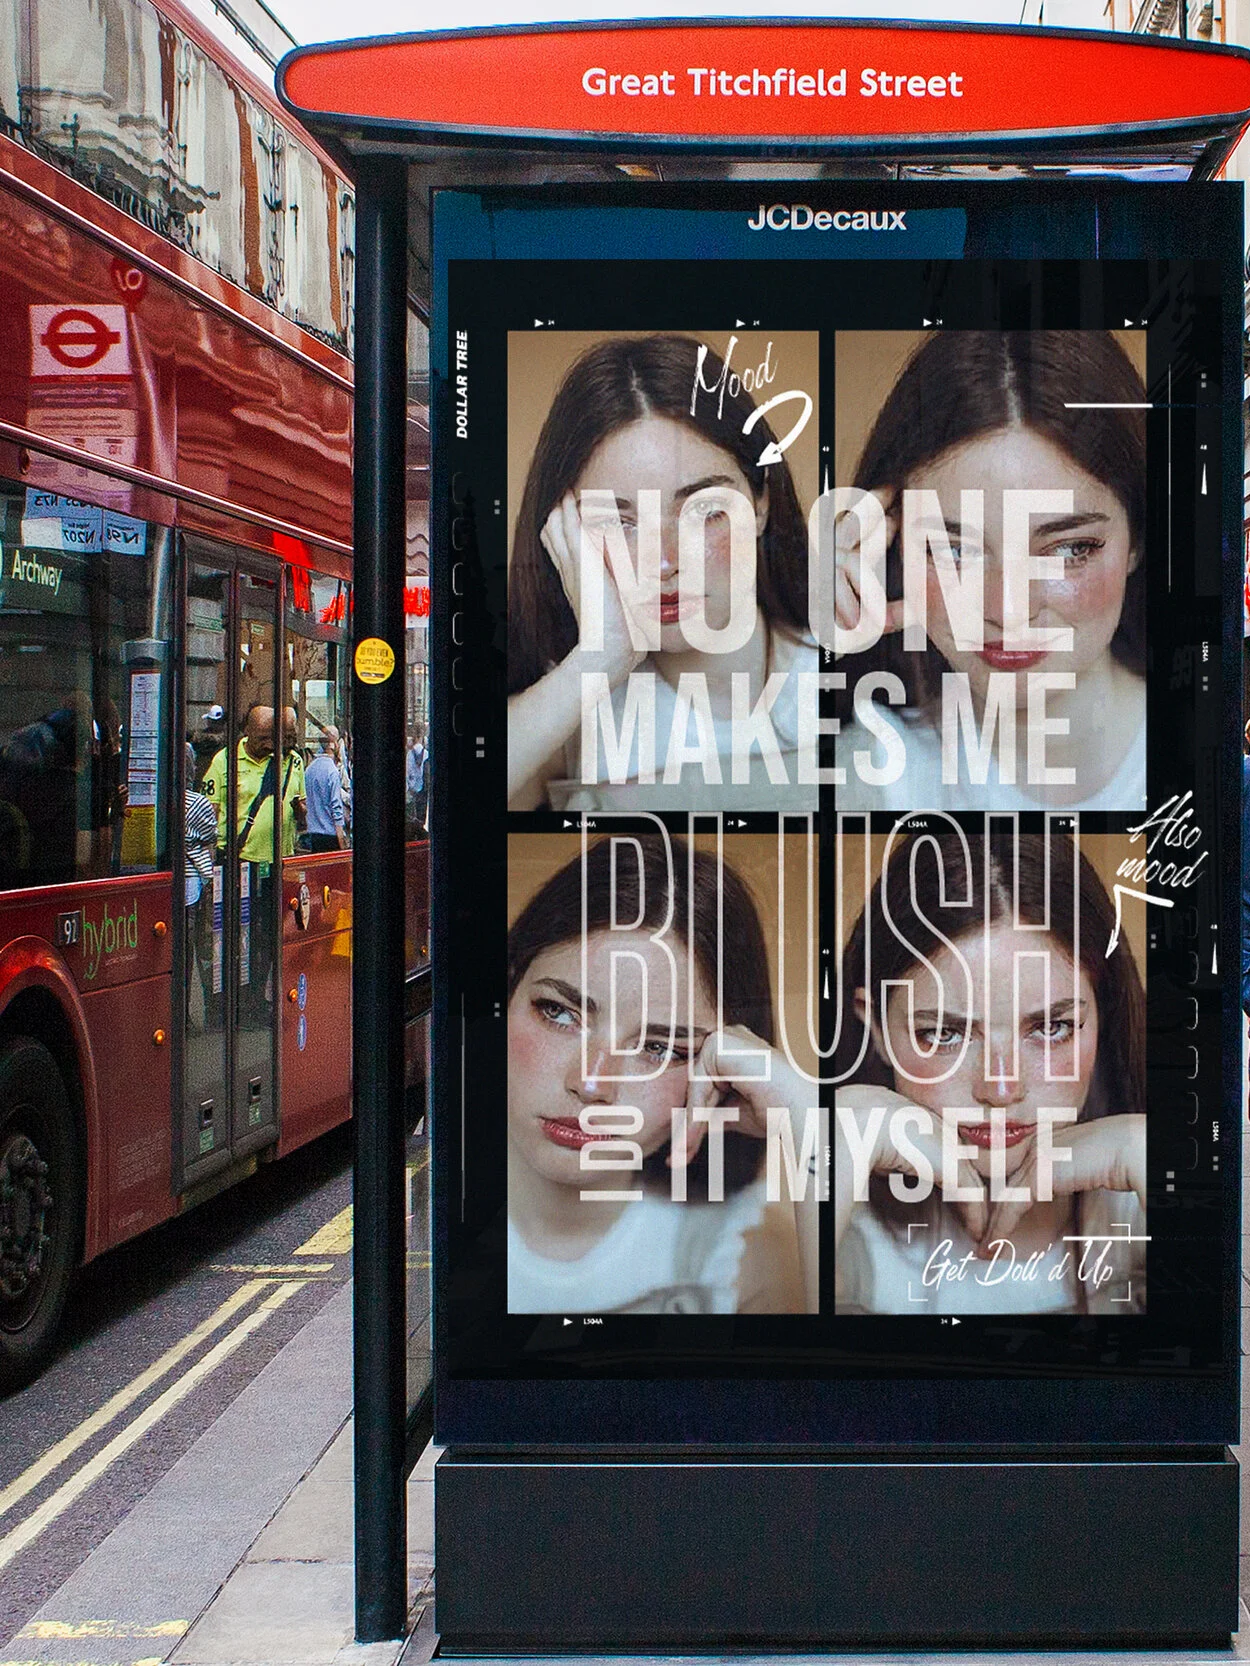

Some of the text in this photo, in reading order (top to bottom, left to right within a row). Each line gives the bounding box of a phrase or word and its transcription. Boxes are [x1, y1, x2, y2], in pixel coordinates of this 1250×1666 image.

[582, 67, 964, 98] Great Titchfield Street
[747, 203, 908, 232] JCDecaux
[456, 330, 469, 439] DOLLAR TREE
[690, 335, 779, 420] Mood
[11, 549, 63, 596] Archway
[580, 486, 1075, 655] NO ONE
[580, 671, 1077, 786] MAKES ME
[1127, 790, 1203, 854] Also
[1116, 850, 1209, 888] mood
[82, 898, 138, 980] hybrid
[581, 810, 1081, 1085] BLUSH
[578, 1105, 645, 1201] I DO
[671, 1106, 1077, 1204] IT MYSELF
[922, 1238, 1113, 1290] Get Doll'd Up
